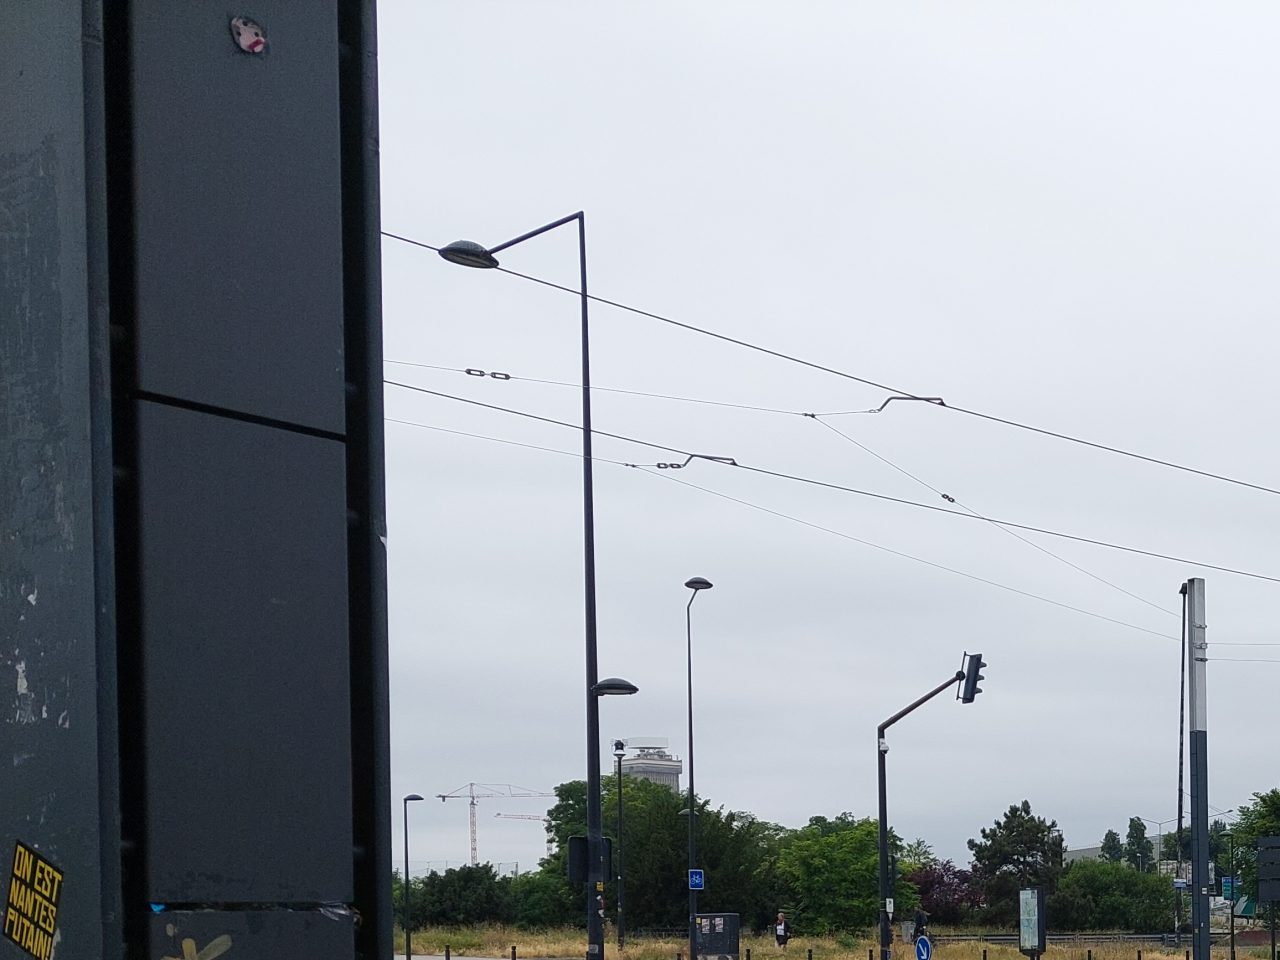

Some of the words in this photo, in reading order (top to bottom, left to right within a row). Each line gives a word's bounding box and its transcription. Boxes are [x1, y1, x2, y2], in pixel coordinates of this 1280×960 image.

[14, 844, 33, 884] ON
[34, 858, 62, 903] EST
[9, 877, 57, 934] NANTES
